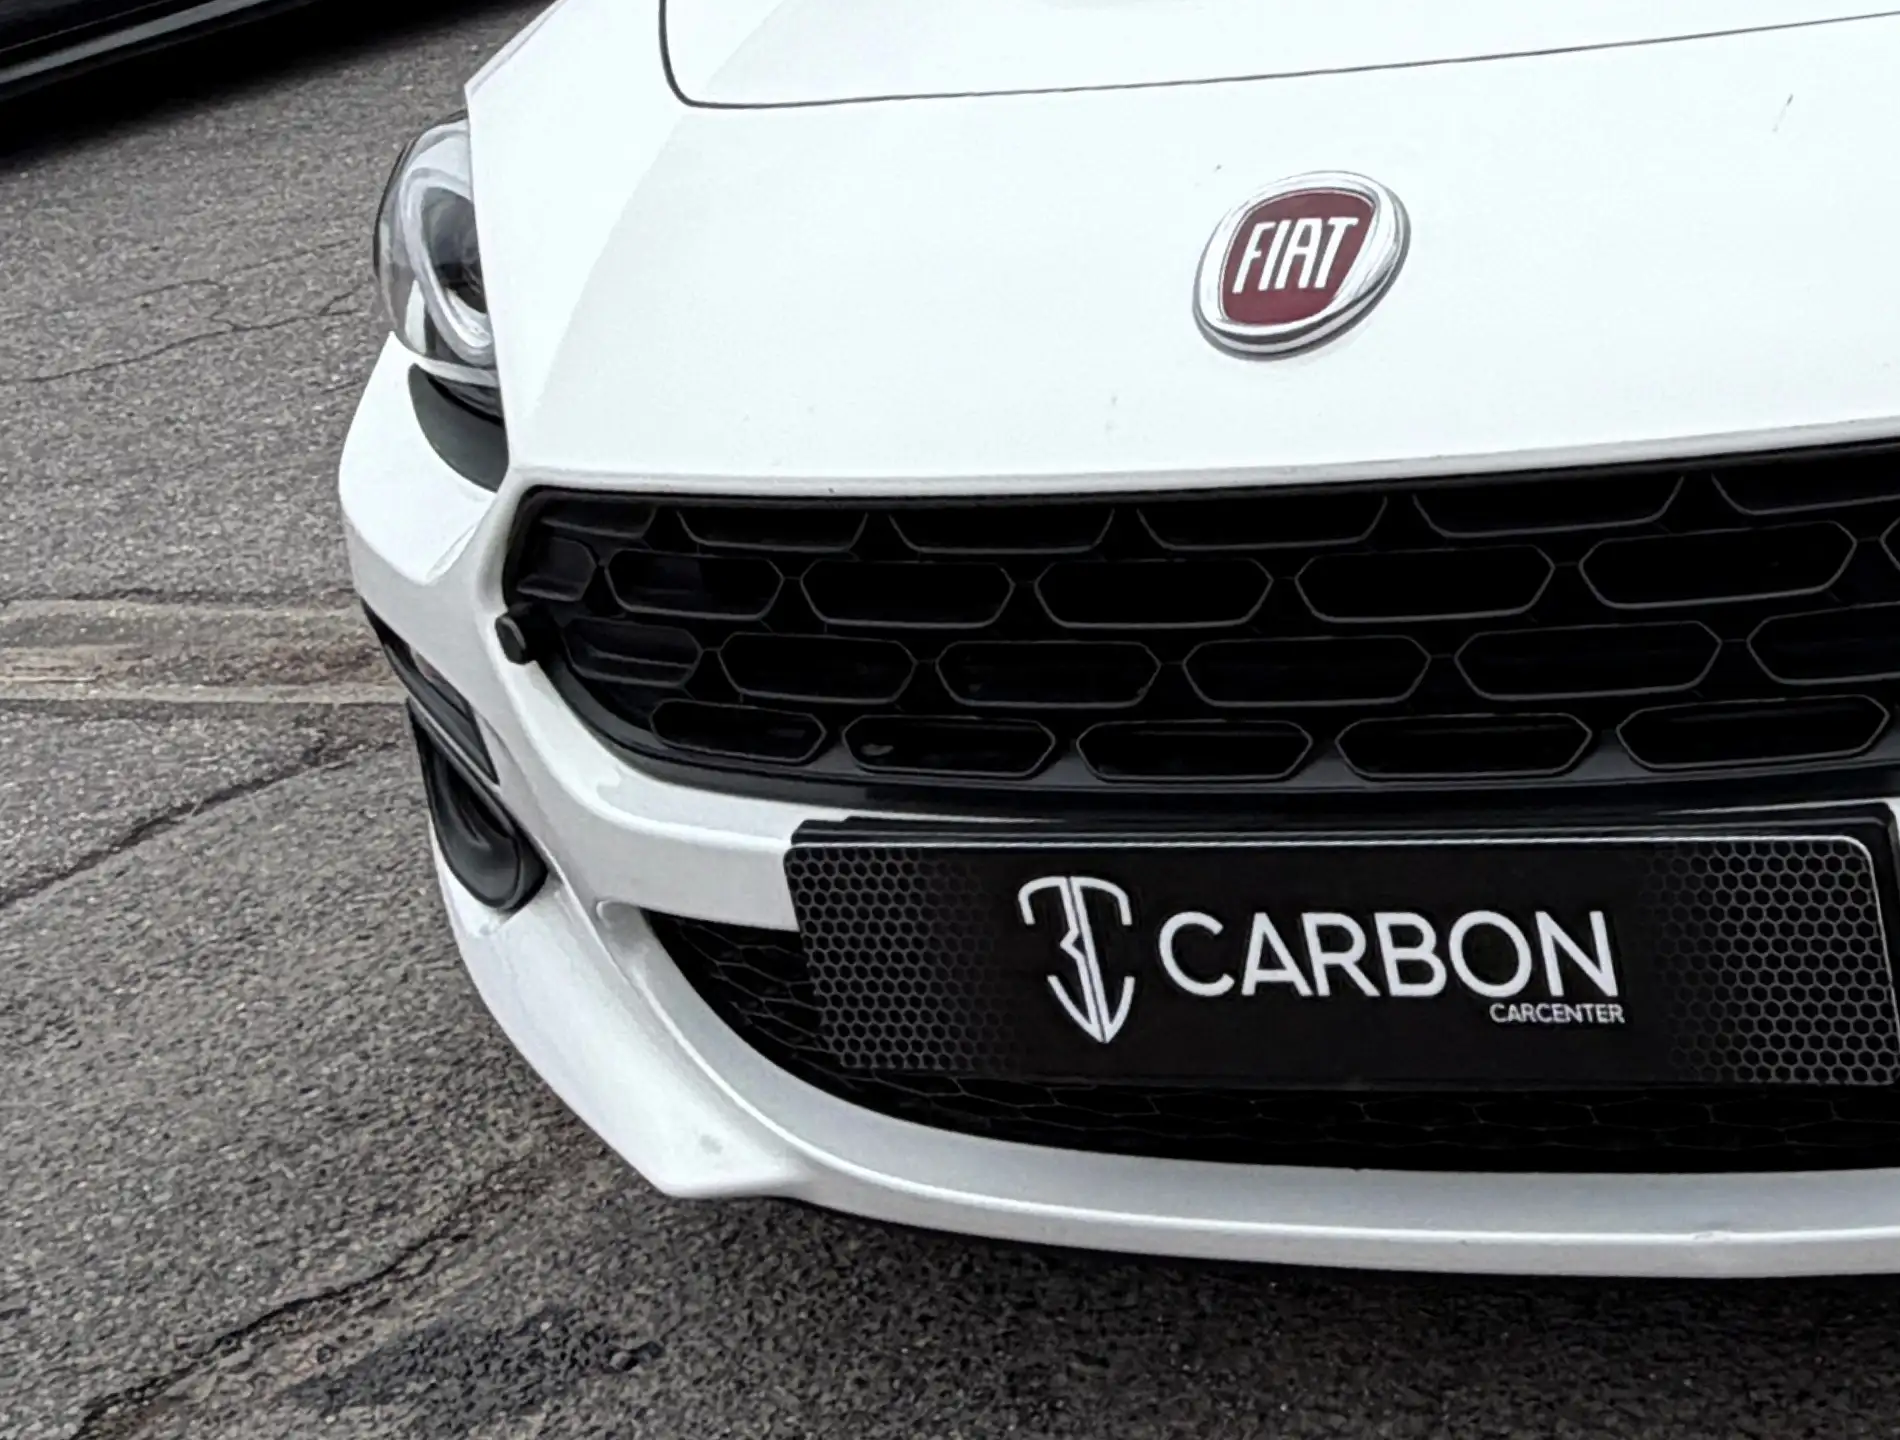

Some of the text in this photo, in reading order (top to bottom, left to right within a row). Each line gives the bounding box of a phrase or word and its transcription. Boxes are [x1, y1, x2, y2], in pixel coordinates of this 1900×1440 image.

[1232, 216, 1360, 294] FIAT
[1158, 909, 1619, 998] CARBON
[1489, 1002, 1626, 1024] CARCENTER
